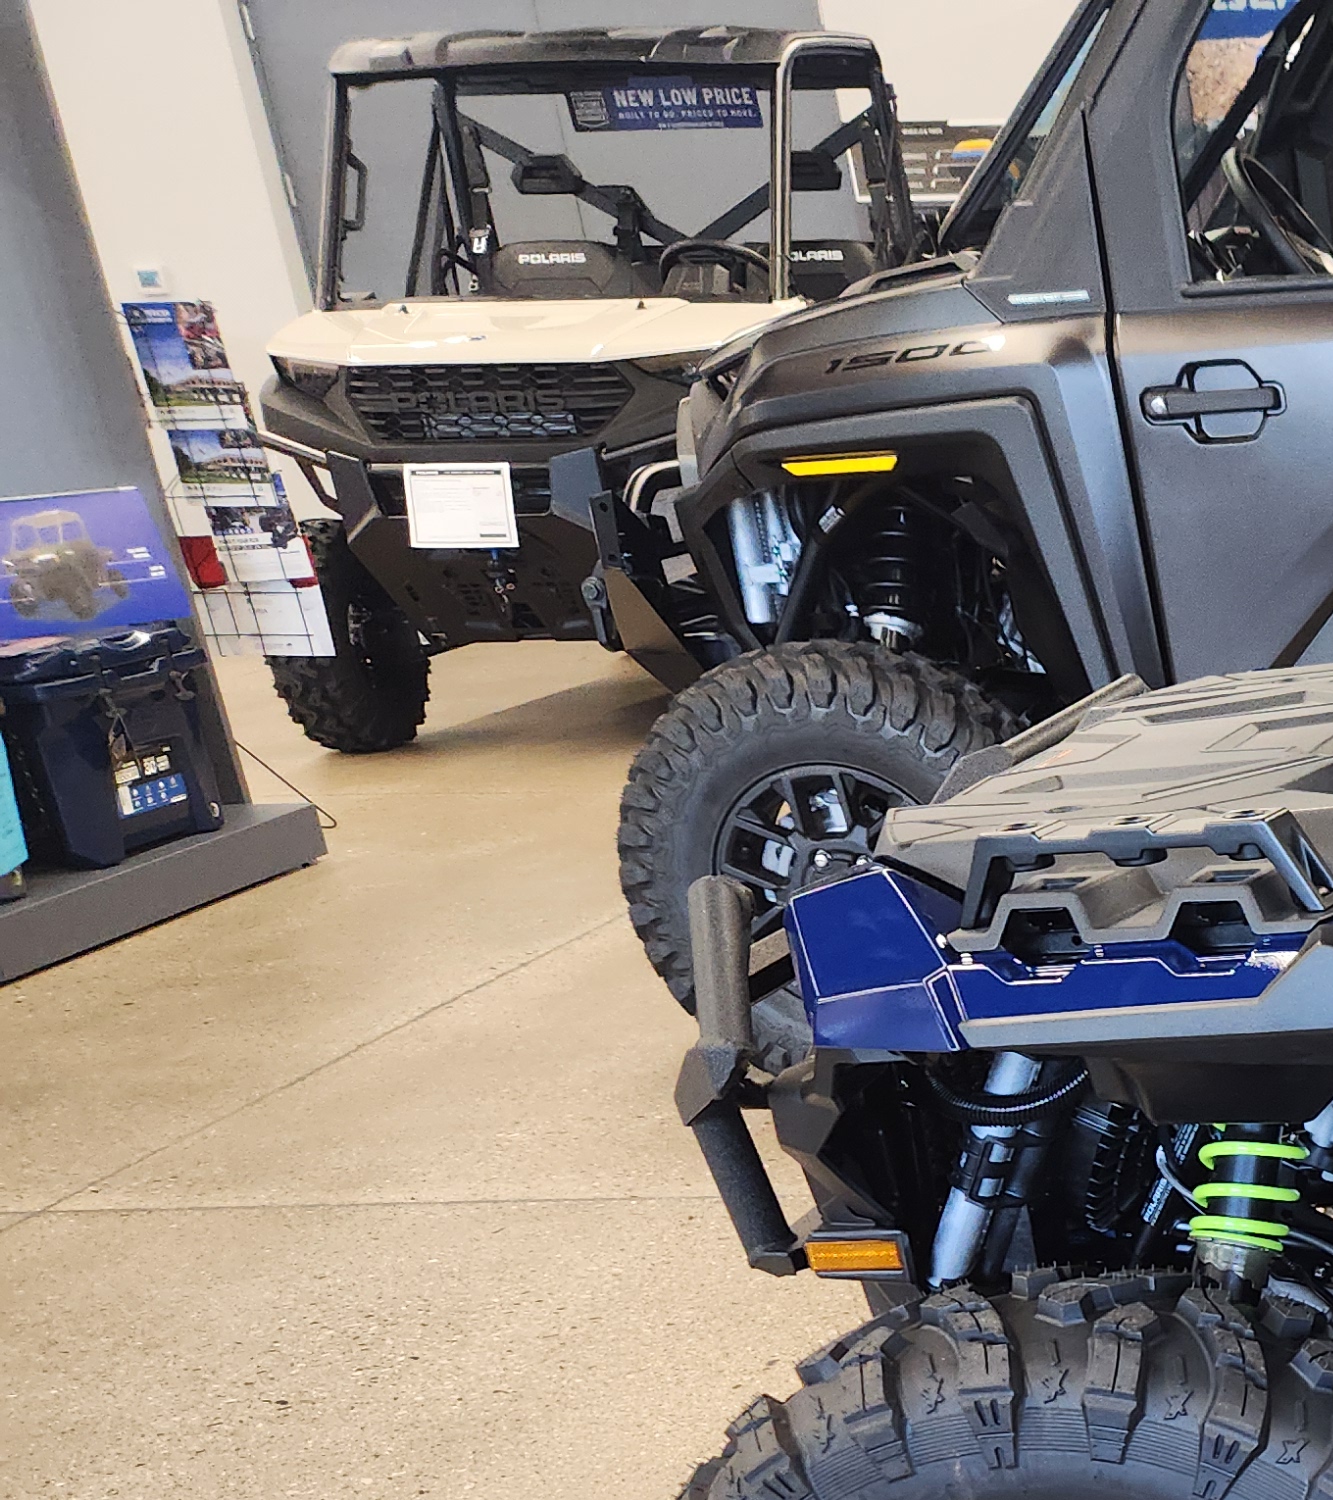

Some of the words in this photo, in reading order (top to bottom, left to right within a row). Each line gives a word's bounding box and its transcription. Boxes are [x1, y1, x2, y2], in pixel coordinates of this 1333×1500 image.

[612, 89, 654, 108] NEW
[659, 88, 699, 107] LOW
[702, 87, 755, 106] PRICE
[649, 110, 660, 119] TO
[681, 109, 714, 118] PRICED
[716, 109, 728, 118] TO
[518, 252, 586, 265] POLARIS
[788, 250, 844, 262] OLARIS
[390, 389, 566, 413] POLARIS
[1142, 1177, 1168, 1223] POLARIS
